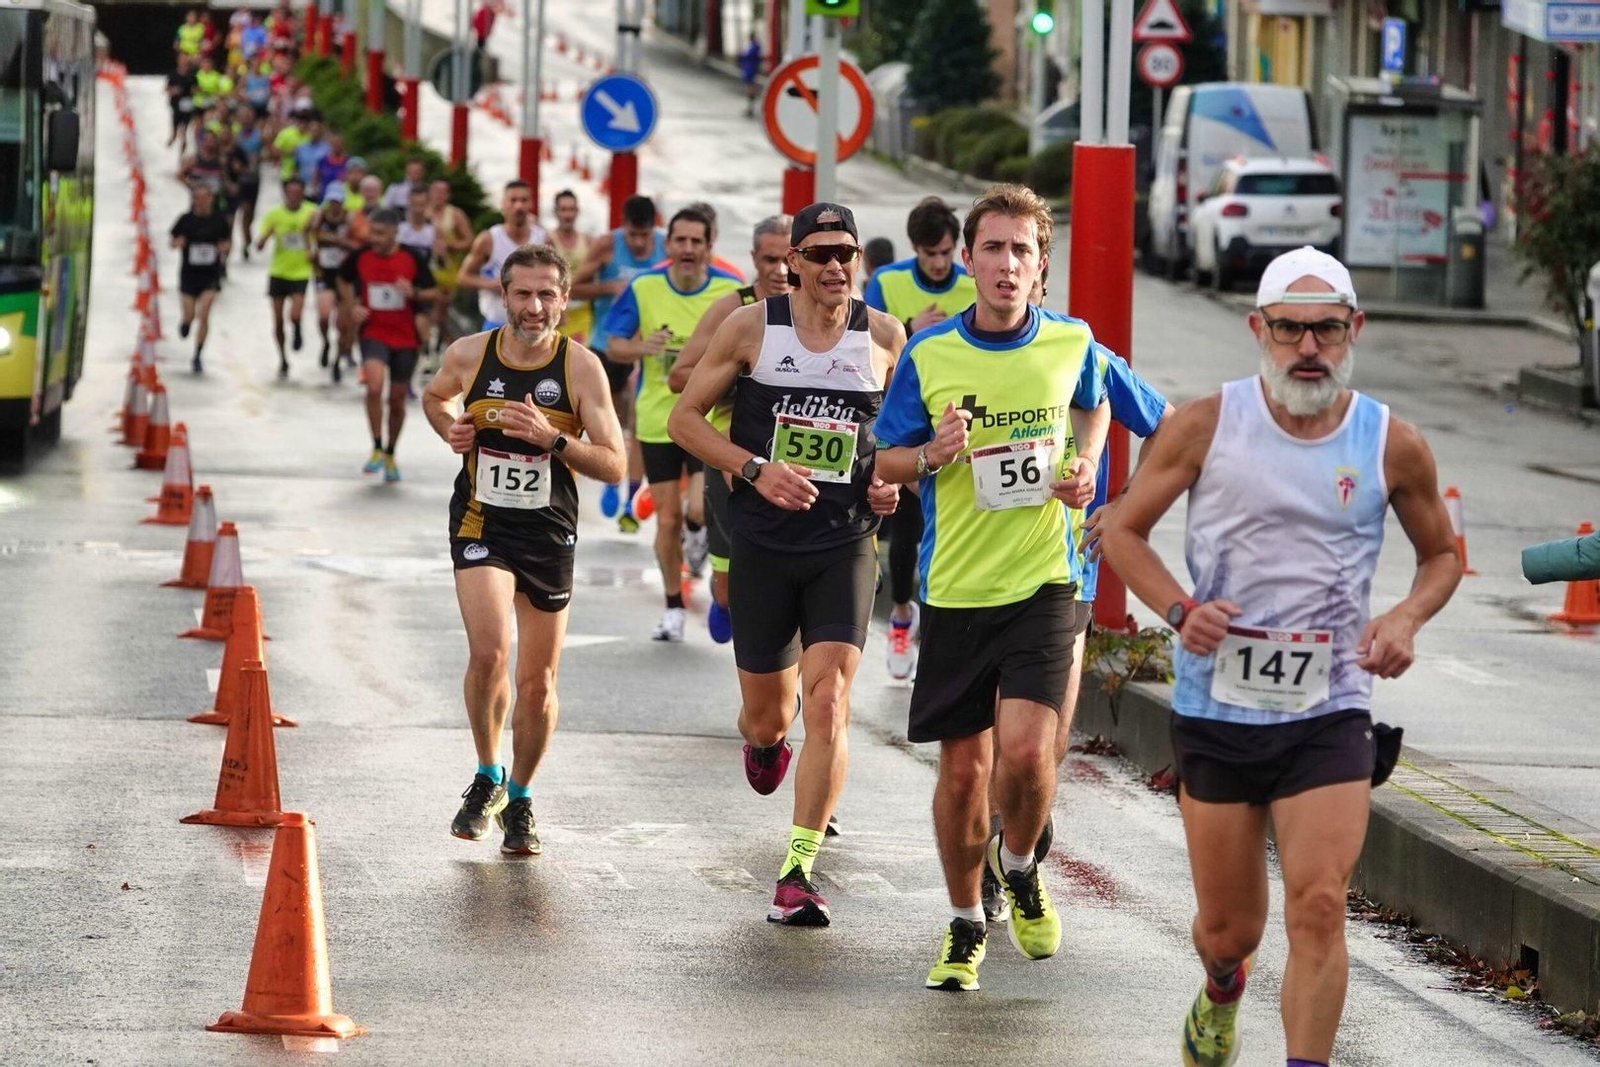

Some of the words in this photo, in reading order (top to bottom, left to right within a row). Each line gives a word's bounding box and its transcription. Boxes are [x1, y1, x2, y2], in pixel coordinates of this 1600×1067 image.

[982, 404, 1065, 429] DEPORTE
[1009, 424, 1061, 439] Atlánti
[786, 431, 844, 463] 530
[489, 465, 541, 492] 152
[999, 456, 1041, 488] 56
[1237, 646, 1314, 686] 147
